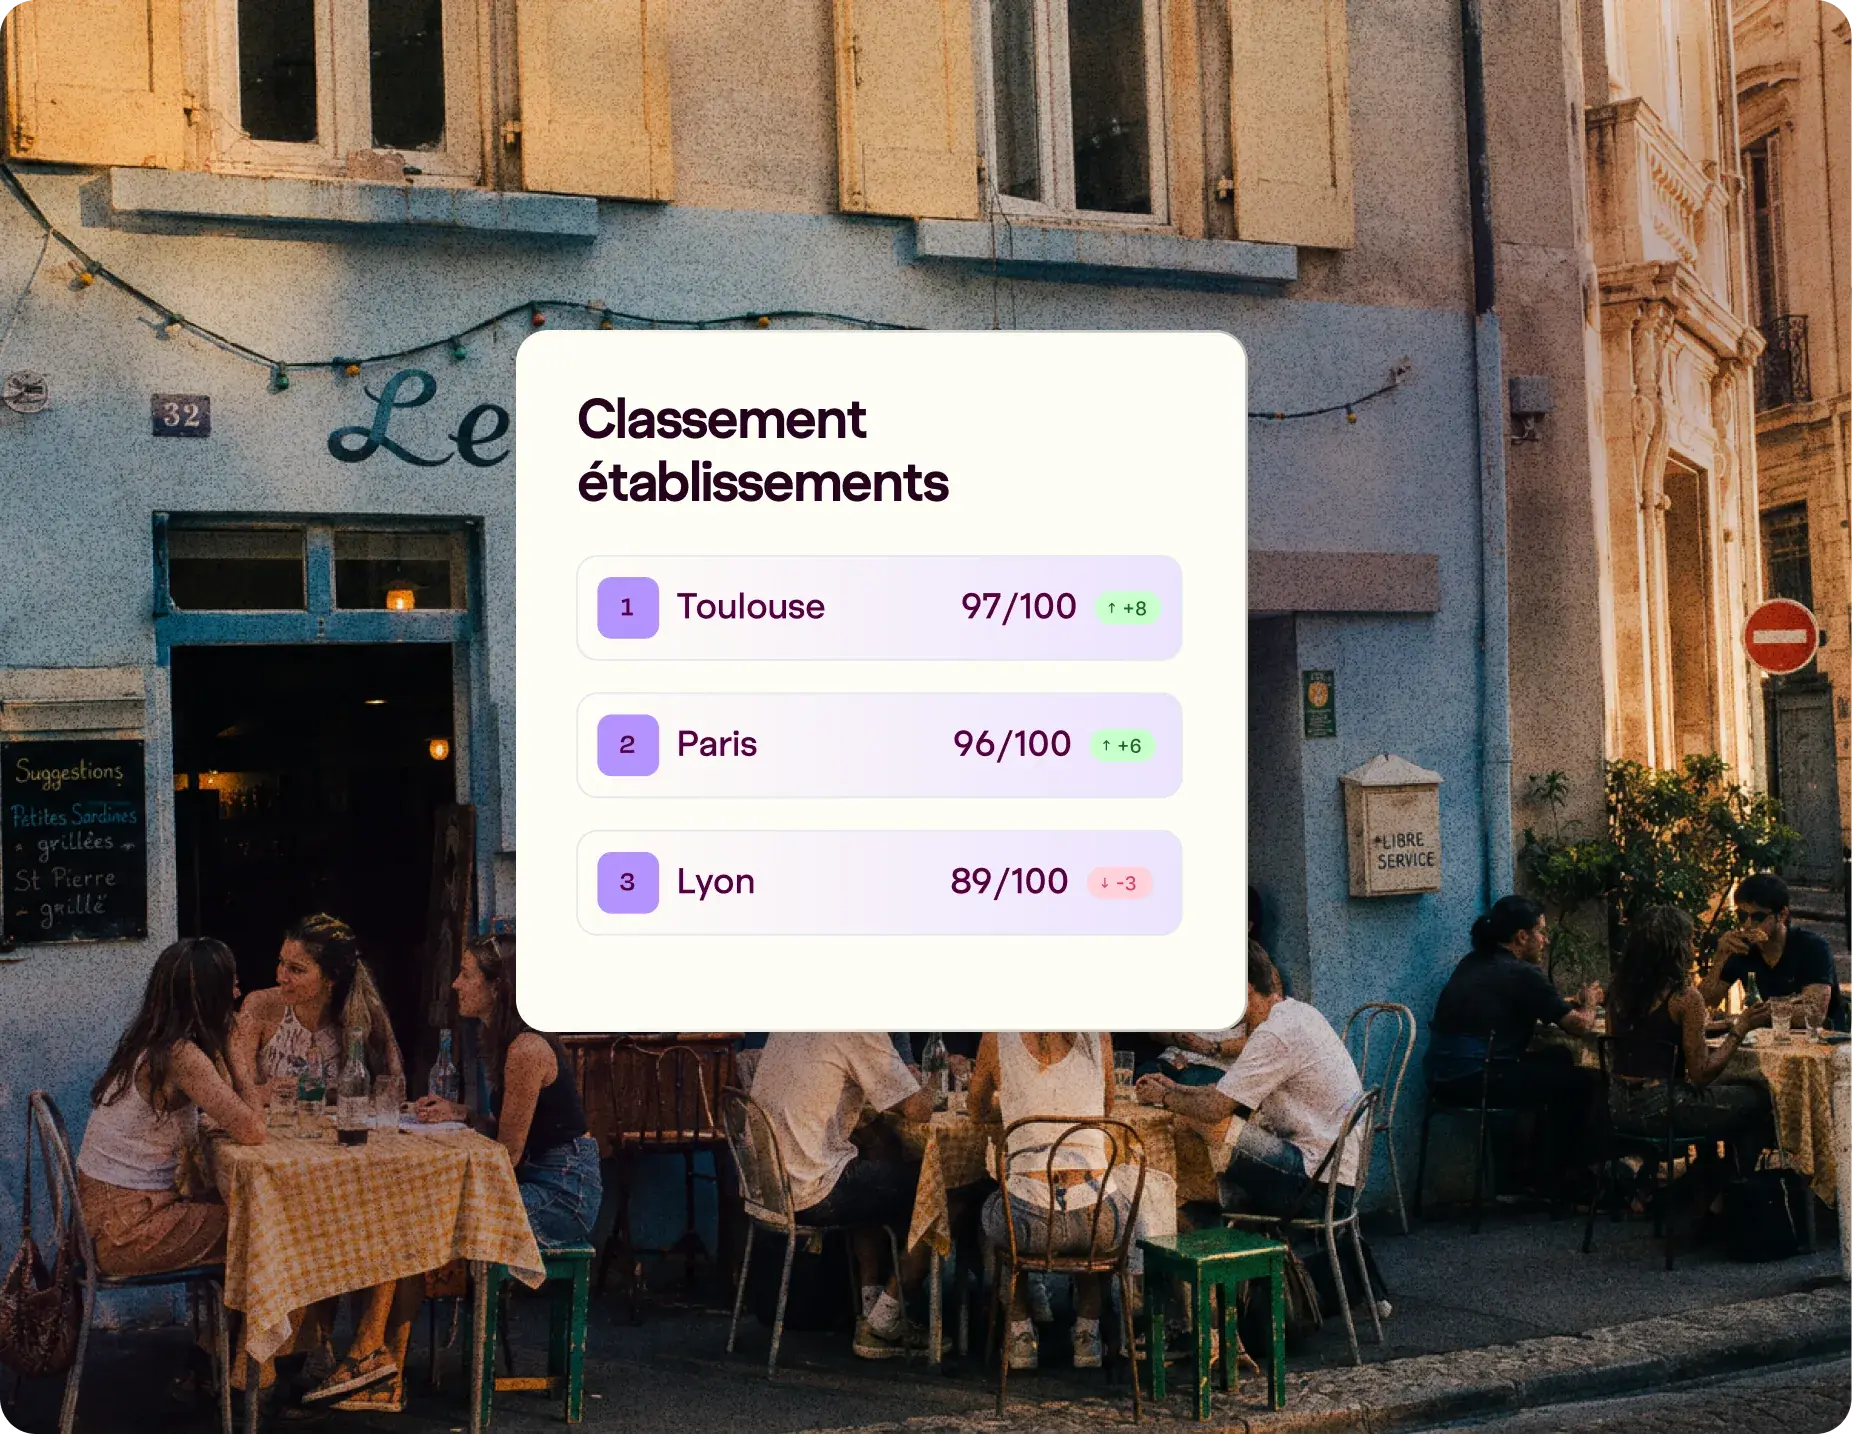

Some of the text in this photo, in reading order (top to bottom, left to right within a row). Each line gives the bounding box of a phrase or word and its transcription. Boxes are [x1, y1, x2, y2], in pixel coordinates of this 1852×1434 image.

[163, 402, 200, 428] 32
[327, 368, 511, 467] Le
[15, 757, 125, 792] Suggestions
[10, 801, 138, 829] Petites Sardines
[1382, 831, 1425, 850] LIBRE
[1377, 851, 1436, 870] SERVICE
[14, 866, 117, 892] St Pierre
